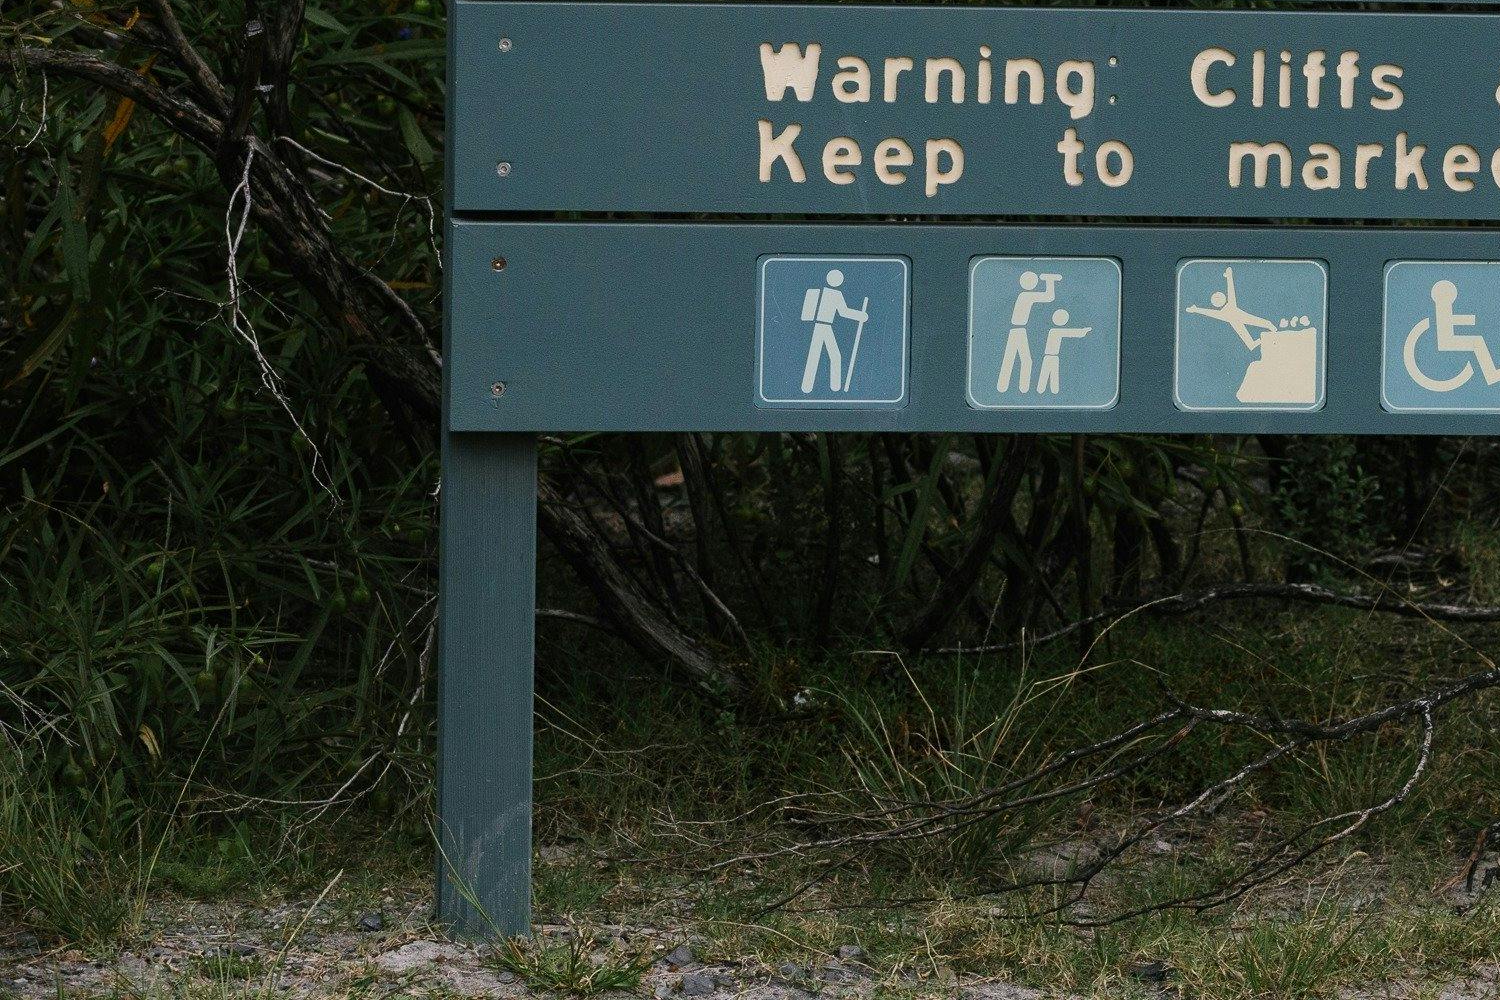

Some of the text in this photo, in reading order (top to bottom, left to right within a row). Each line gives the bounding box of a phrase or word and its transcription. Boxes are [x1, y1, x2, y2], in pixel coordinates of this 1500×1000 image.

[758, 42, 1117, 120] Warning:
[1189, 47, 1405, 111] Cliffs
[757, 119, 966, 197] Keep
[1056, 128, 1135, 188] to
